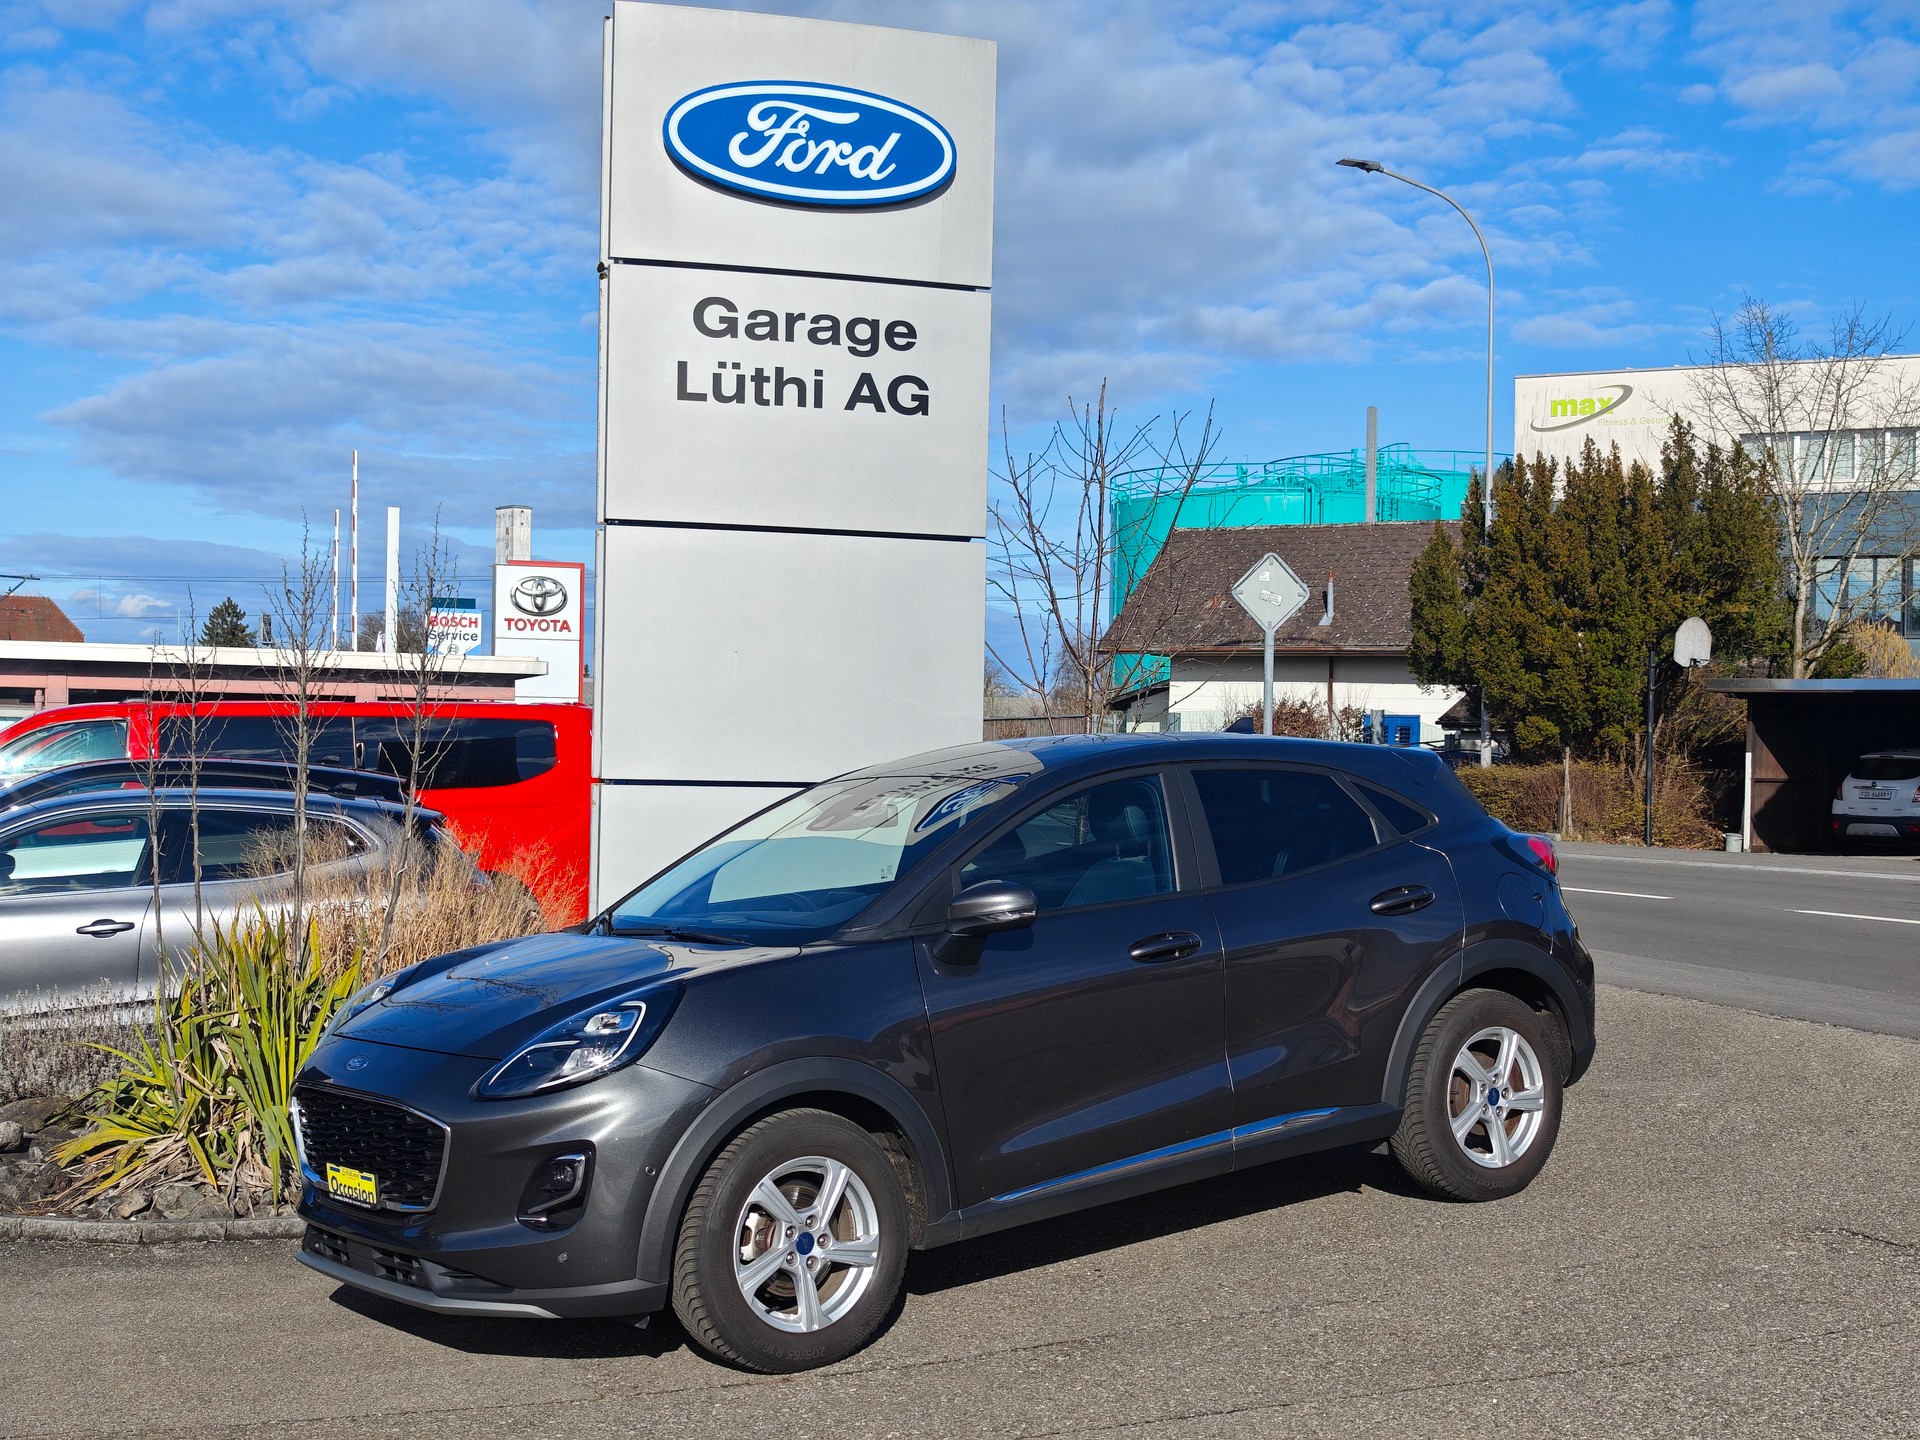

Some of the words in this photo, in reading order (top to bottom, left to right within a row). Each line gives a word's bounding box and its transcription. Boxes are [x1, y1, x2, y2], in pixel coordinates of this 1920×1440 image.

[728, 100, 902, 181] Ford
[692, 296, 918, 358] Garage
[676, 360, 824, 409] Lüthi
[843, 372, 930, 416] AG
[1550, 395, 1614, 417] max
[1597, 418, 1628, 427] Fitness
[1630, 417, 1637, 425] &
[1639, 415, 1680, 425] Gesund
[429, 615, 479, 629] BOSCH
[504, 617, 572, 633] TOYOTA
[428, 629, 479, 642] Service
[331, 1175, 375, 1205] Occasion
[785, 1346, 826, 1361] 205/65
